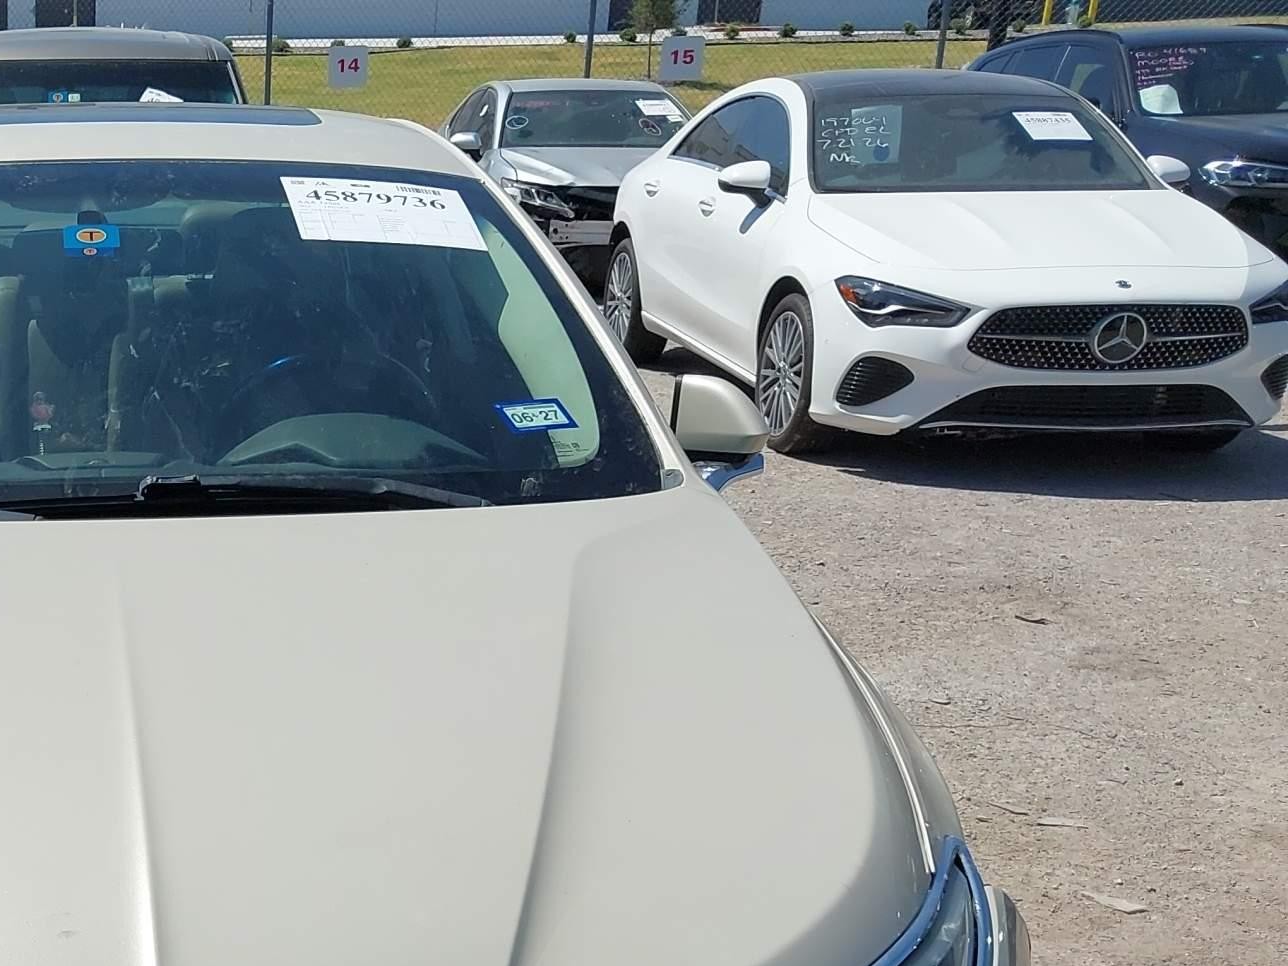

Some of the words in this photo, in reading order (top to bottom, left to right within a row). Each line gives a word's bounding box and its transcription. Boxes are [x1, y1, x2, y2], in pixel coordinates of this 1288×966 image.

[670, 49, 695, 65] 15
[337, 58, 360, 73] 14
[305, 189, 447, 211] 45879736
